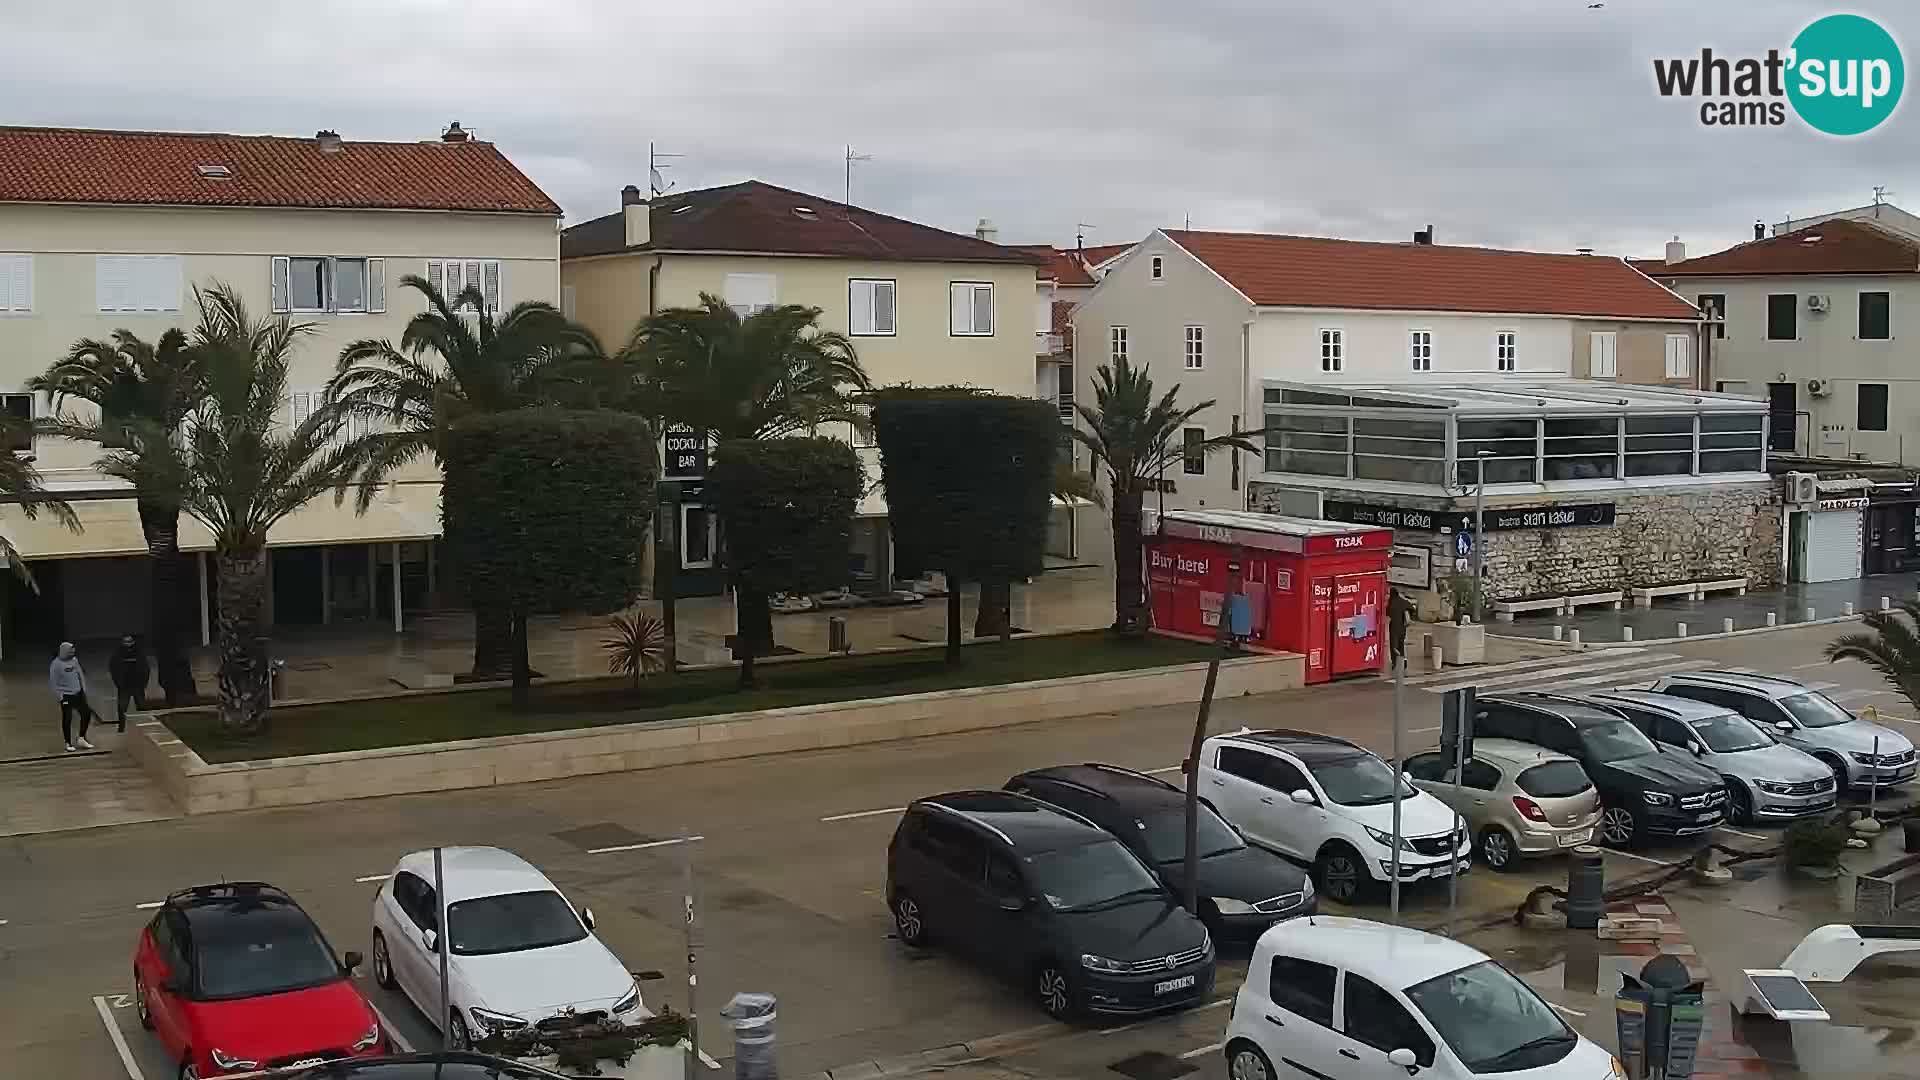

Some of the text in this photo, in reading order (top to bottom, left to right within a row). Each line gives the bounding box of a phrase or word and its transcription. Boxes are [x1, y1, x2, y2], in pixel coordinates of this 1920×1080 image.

[678, 455, 696, 468] BAR
[1334, 535, 1364, 548] TISAK
[1151, 550, 1209, 574] Buy here!
[1314, 580, 1360, 598] Buy here!
